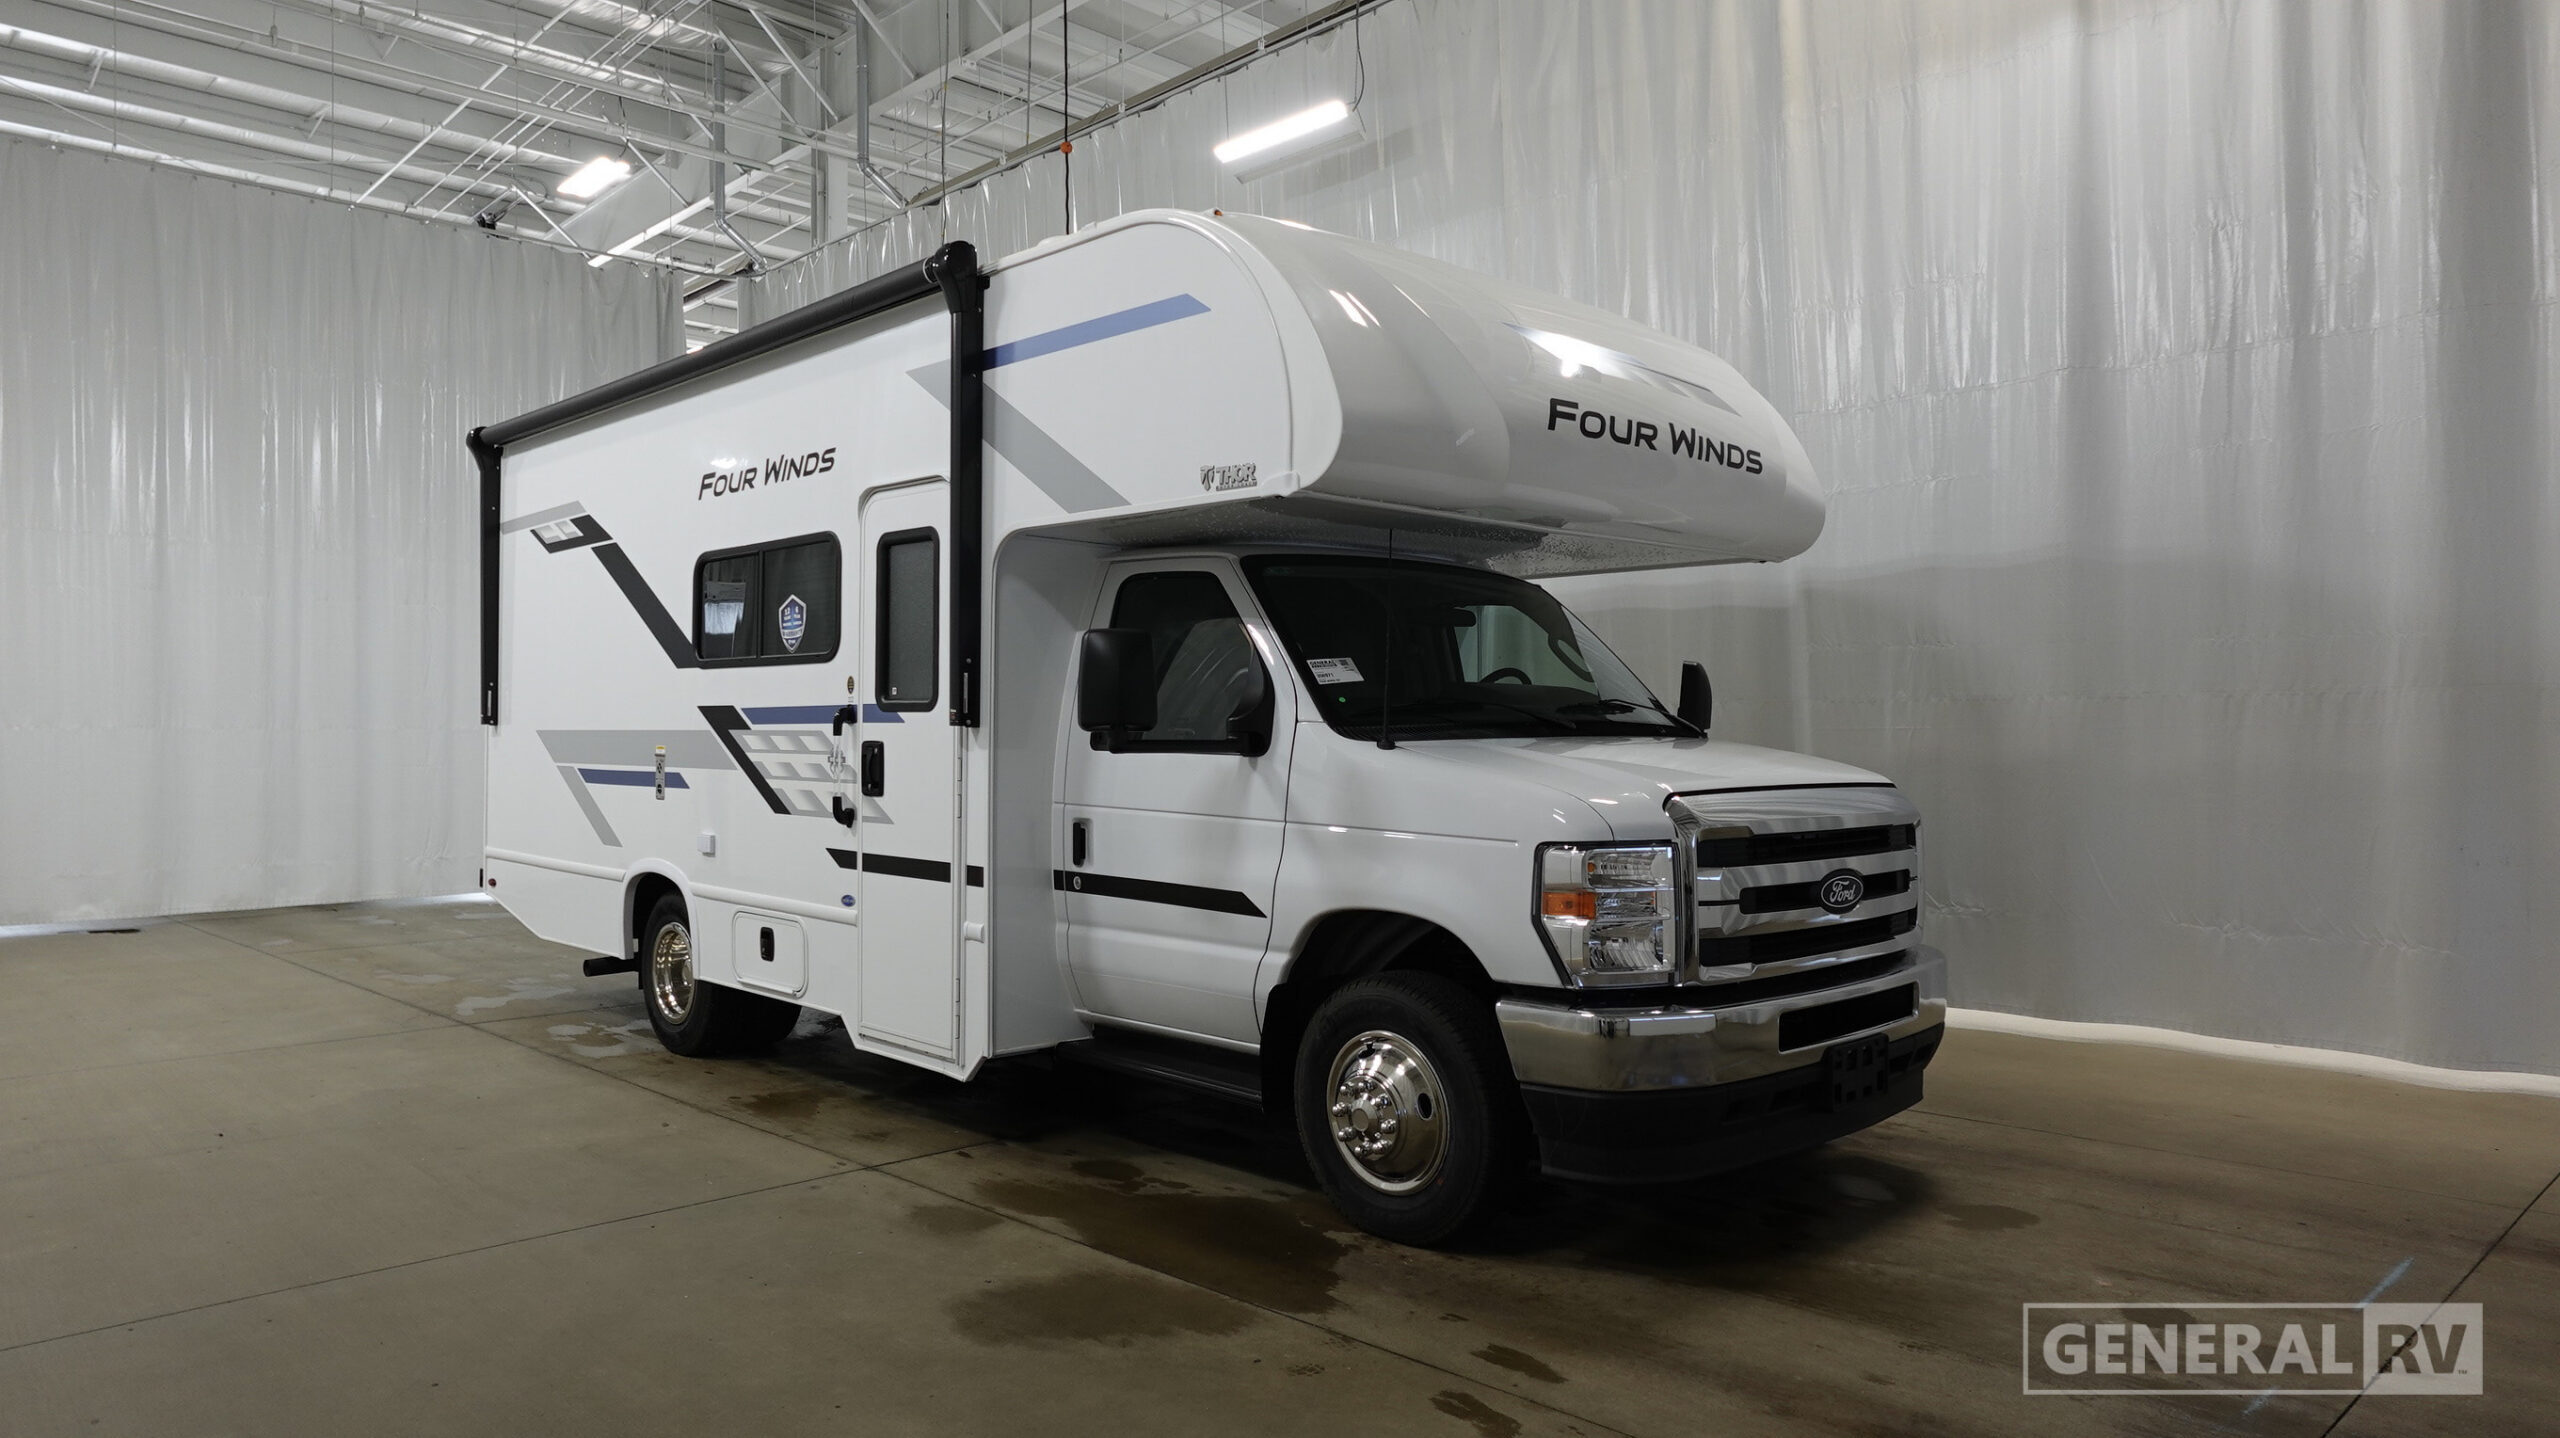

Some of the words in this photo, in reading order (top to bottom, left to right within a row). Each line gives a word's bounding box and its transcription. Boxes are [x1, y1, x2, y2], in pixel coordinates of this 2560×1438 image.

[1547, 398, 1658, 451] FOUR
[1669, 422, 1763, 475] WINDS
[698, 467, 758, 500] FOUR
[764, 447, 837, 485] WINDS
[1216, 462, 1257, 486] THOR
[1829, 880, 1856, 903] Ford
